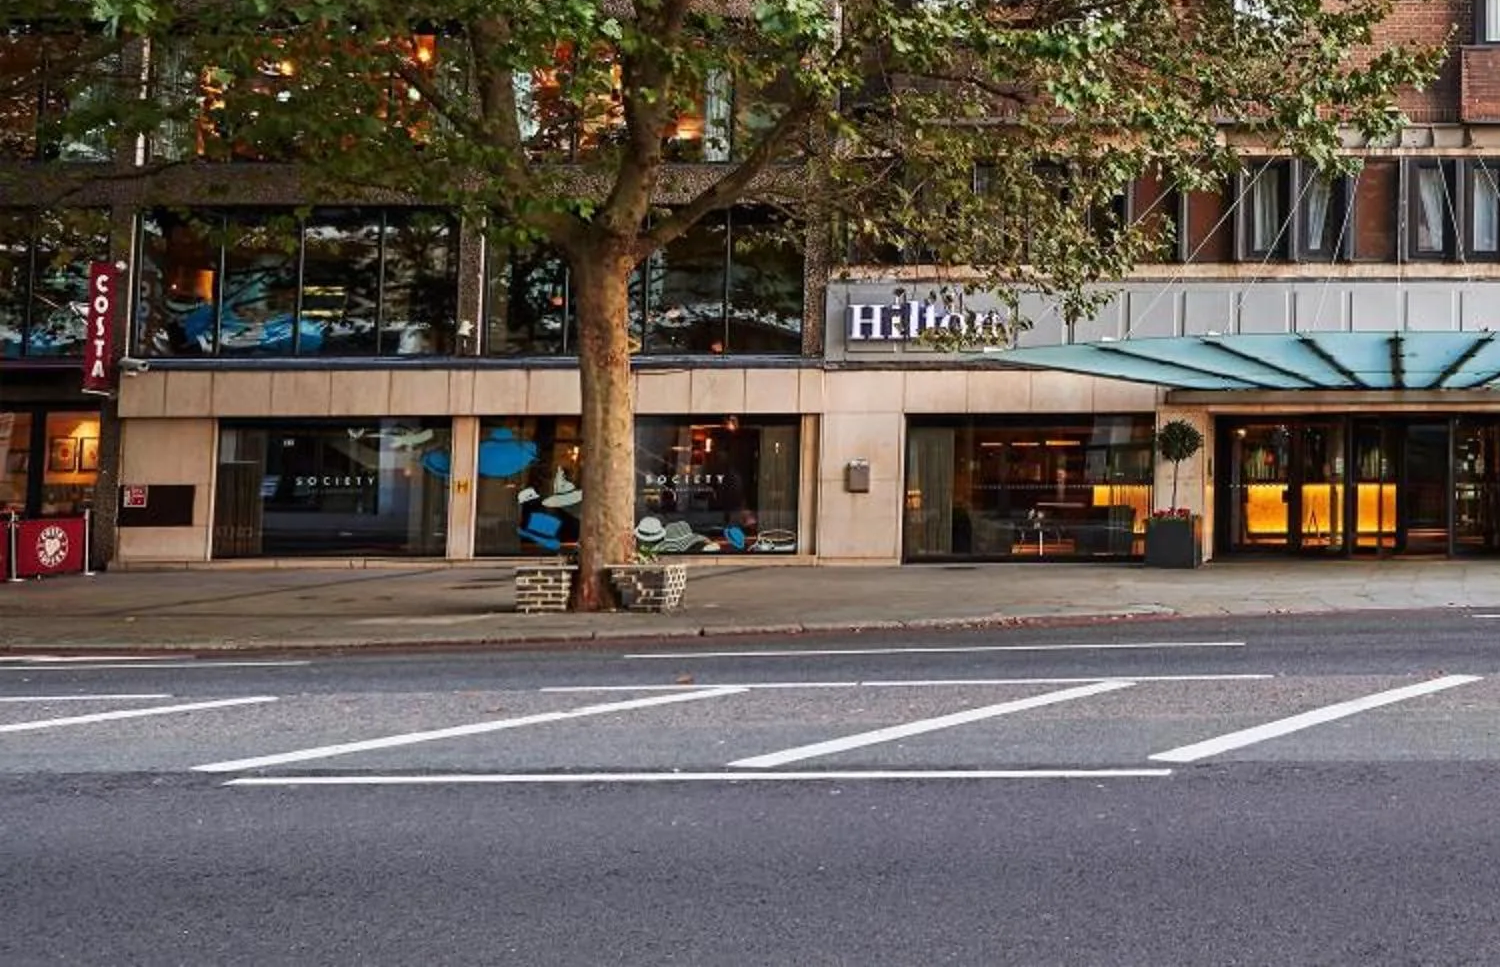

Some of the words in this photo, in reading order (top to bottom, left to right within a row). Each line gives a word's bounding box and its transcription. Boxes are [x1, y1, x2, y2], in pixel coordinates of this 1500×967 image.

[92, 274, 110, 378] COSTA
[295, 476, 375, 486] SOCIETY
[645, 474, 725, 485] SOCIETY
